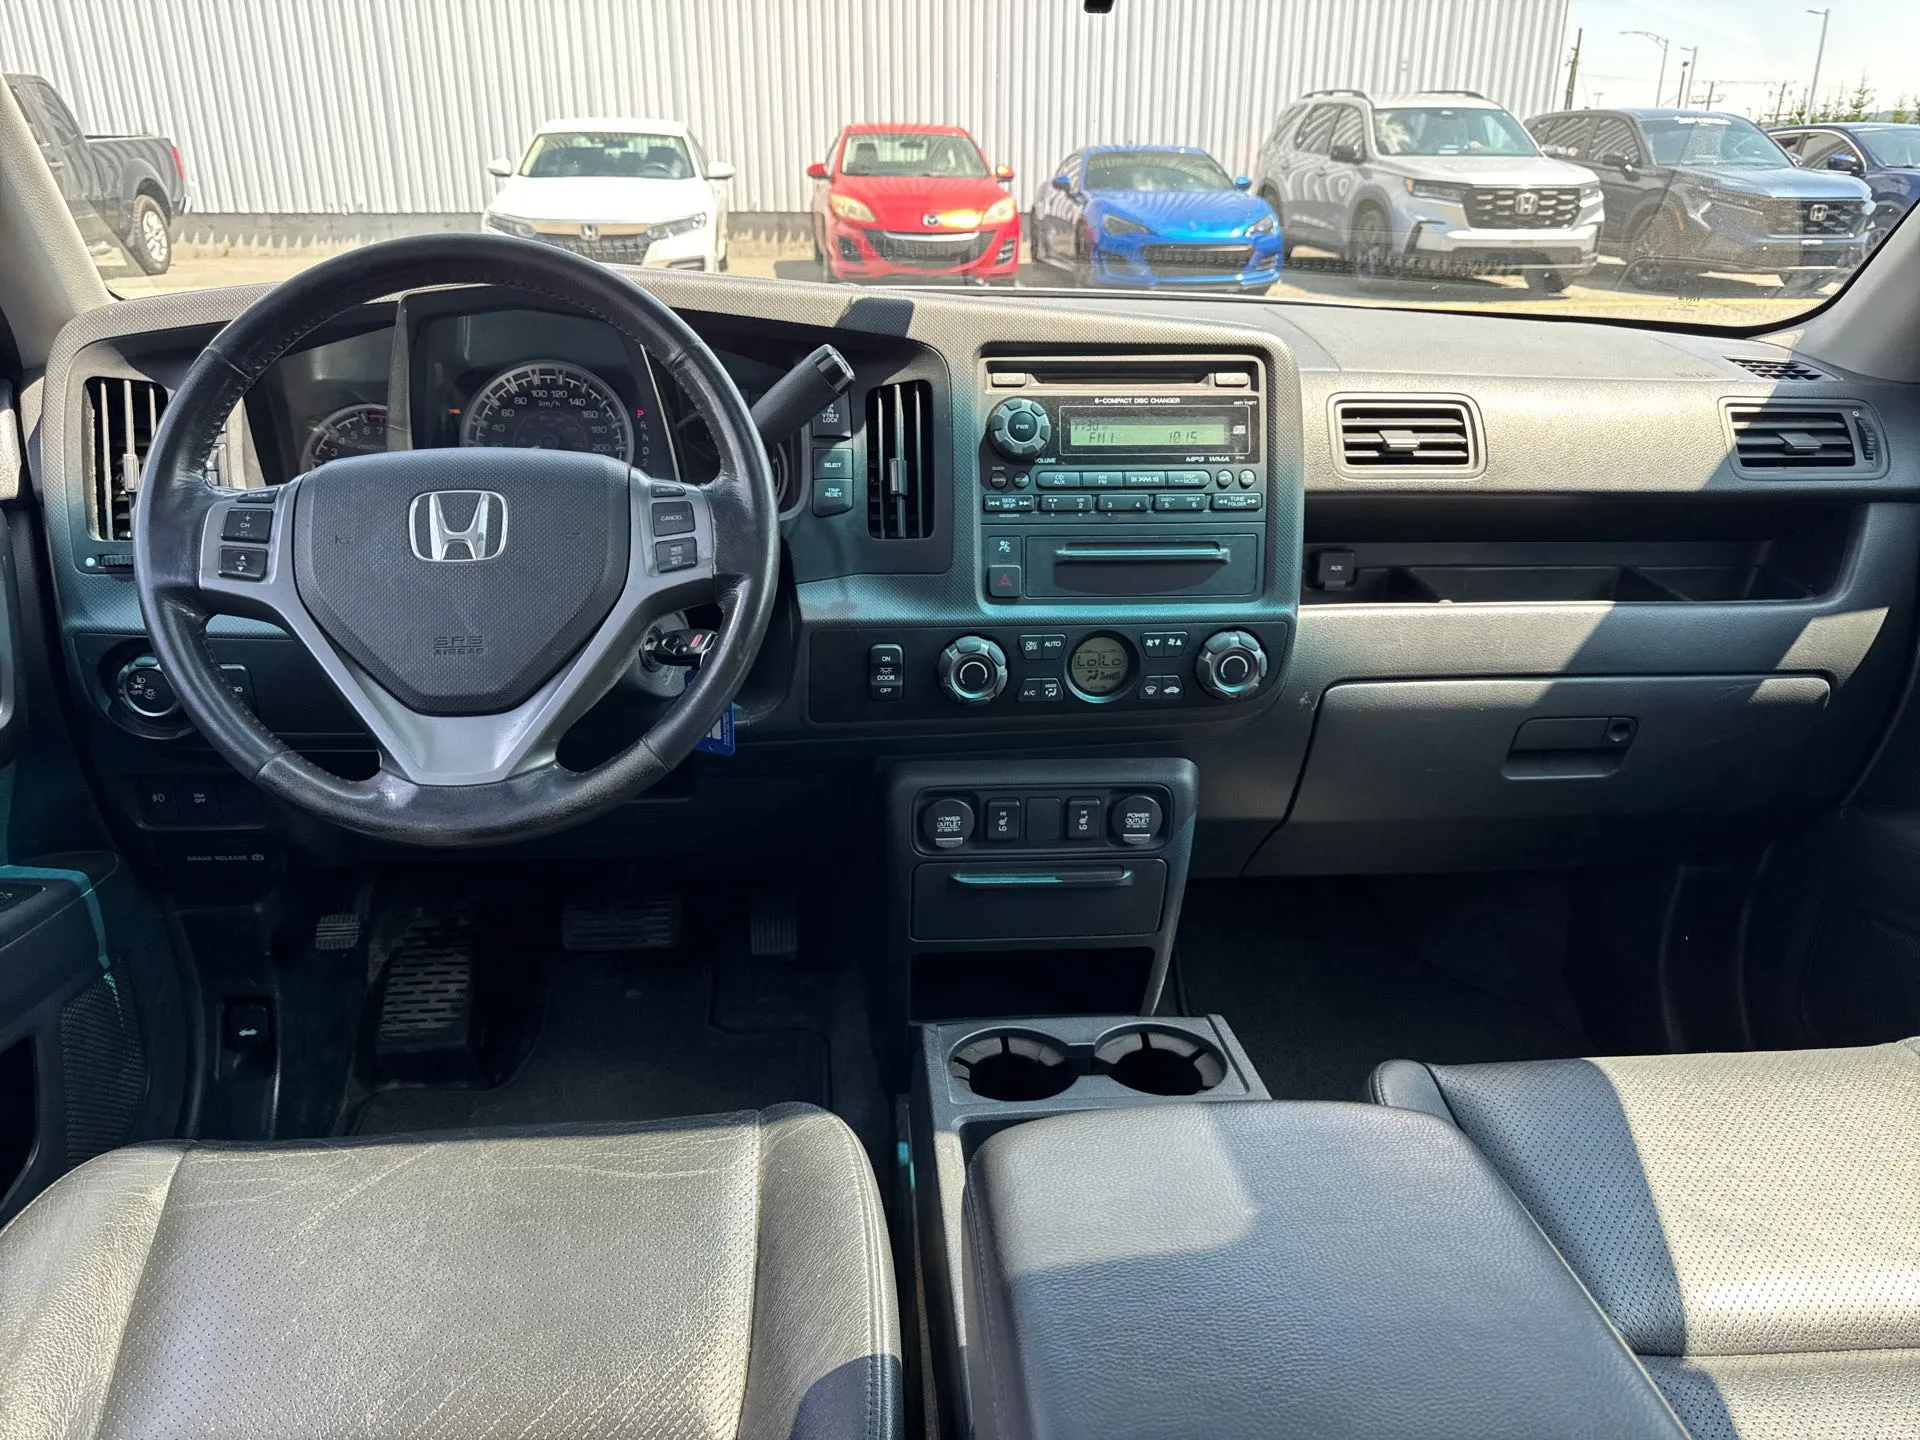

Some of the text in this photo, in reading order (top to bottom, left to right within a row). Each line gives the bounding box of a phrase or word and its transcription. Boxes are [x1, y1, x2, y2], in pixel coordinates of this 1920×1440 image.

[531, 389, 548, 398] 100
[551, 390, 568, 398] 120
[539, 400, 561, 408] km/h
[568, 398, 586, 407] 140
[501, 408, 515, 417] 60
[582, 410, 599, 419] 160
[637, 409, 644, 419] P
[492, 424, 506, 432] 40
[592, 425, 608, 434] 180
[640, 421, 647, 430] R
[350, 431, 358, 440] 5
[363, 427, 370, 436] 6
[376, 427, 383, 436] 7
[642, 433, 649, 442] N
[330, 447, 338, 457] 3
[592, 443, 611, 453] 200
[641, 458, 648, 467] 2
[660, 514, 683, 522] CANCEL
